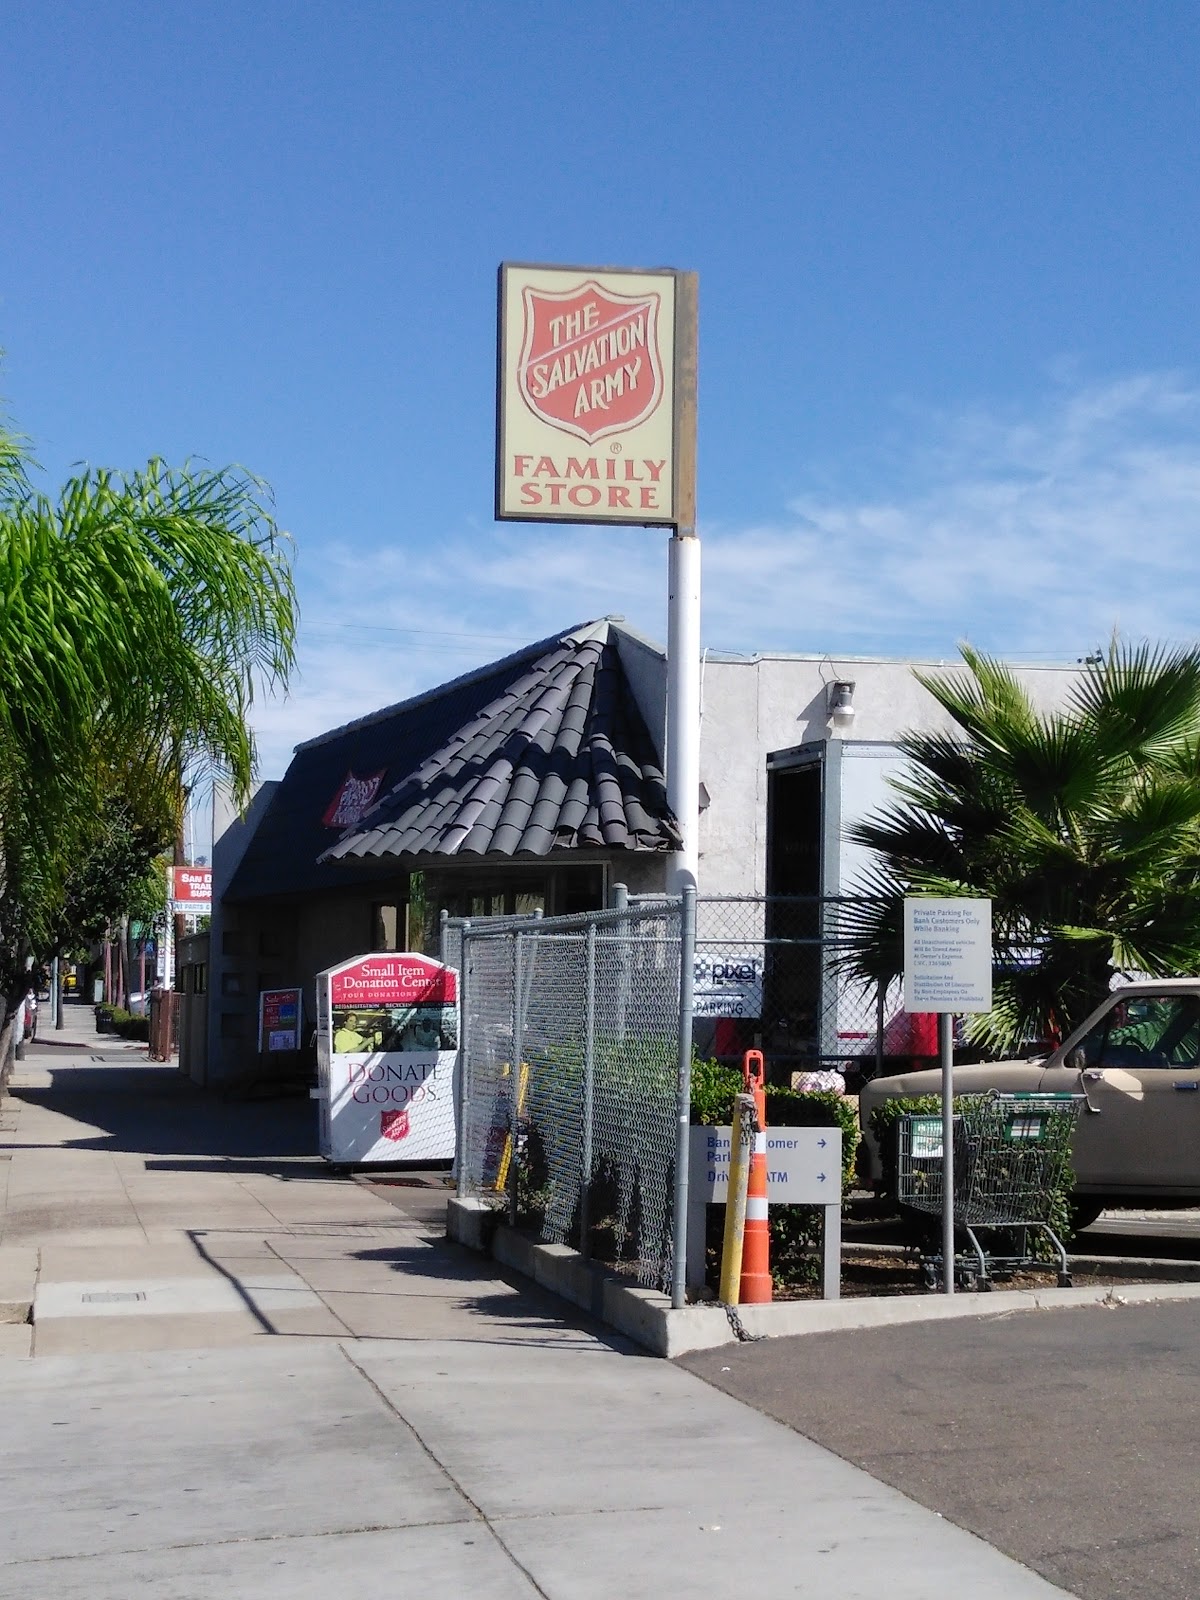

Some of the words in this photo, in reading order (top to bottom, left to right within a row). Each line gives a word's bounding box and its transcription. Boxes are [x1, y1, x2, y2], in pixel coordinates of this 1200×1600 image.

[549, 302, 600, 347] THE
[532, 314, 645, 399] SALVATION
[573, 356, 642, 418] ARMY
[513, 455, 667, 482] FAMILY
[520, 483, 660, 510] STORE
[190, 890, 212, 898] SUPP
[937, 909, 961, 917] Parking
[966, 918, 980, 926] Only
[361, 963, 395, 977] Small
[397, 963, 425, 976] Item
[712, 958, 756, 985] pixel
[343, 976, 399, 989] Donation
[696, 1001, 744, 1015] PARKING
[348, 1062, 442, 1083] DONATE
[707, 1137, 730, 1148] Ban
[766, 1139, 799, 1148] omer
